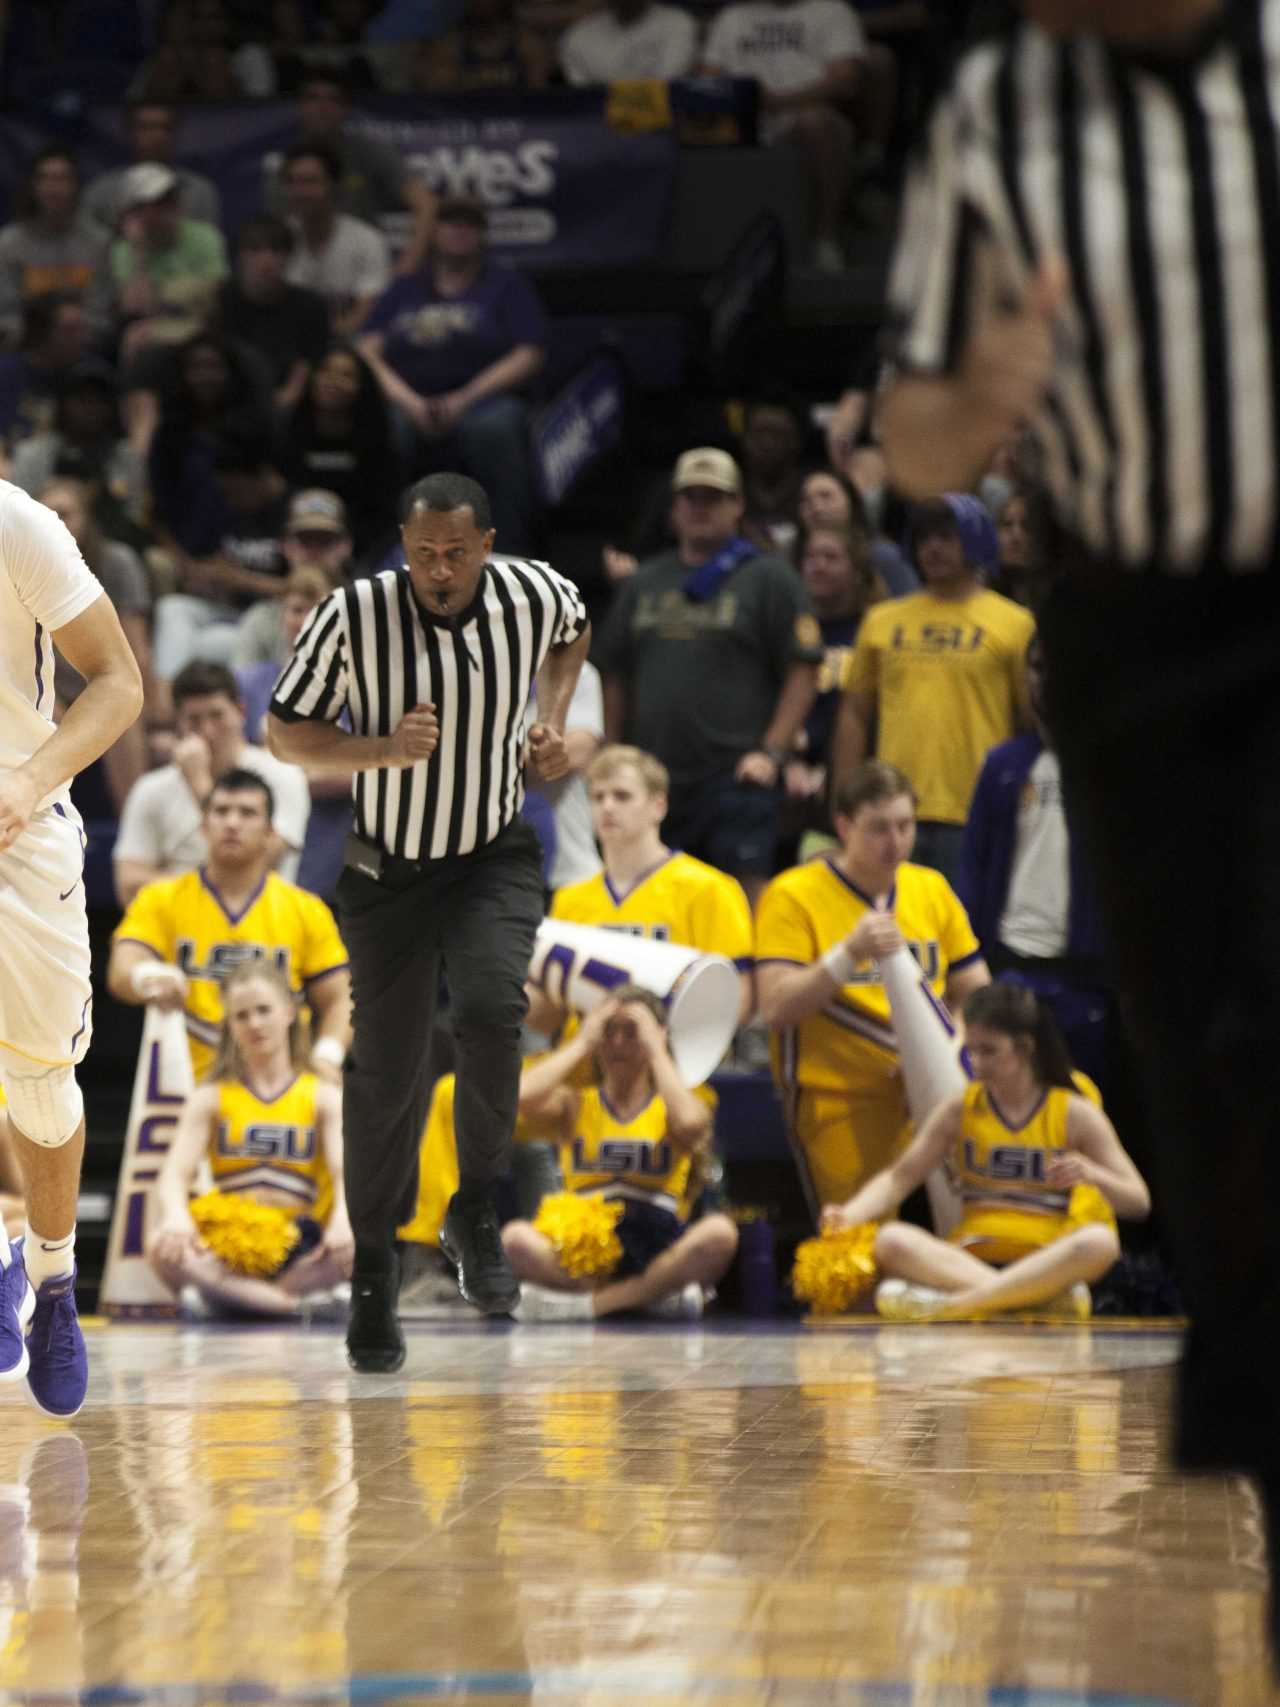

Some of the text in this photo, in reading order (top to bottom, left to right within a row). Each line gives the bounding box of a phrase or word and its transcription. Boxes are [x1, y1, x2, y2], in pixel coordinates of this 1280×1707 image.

[891, 623, 985, 653] LSU
[217, 1120, 316, 1161] LSU
[572, 1136, 671, 1175] LSU
